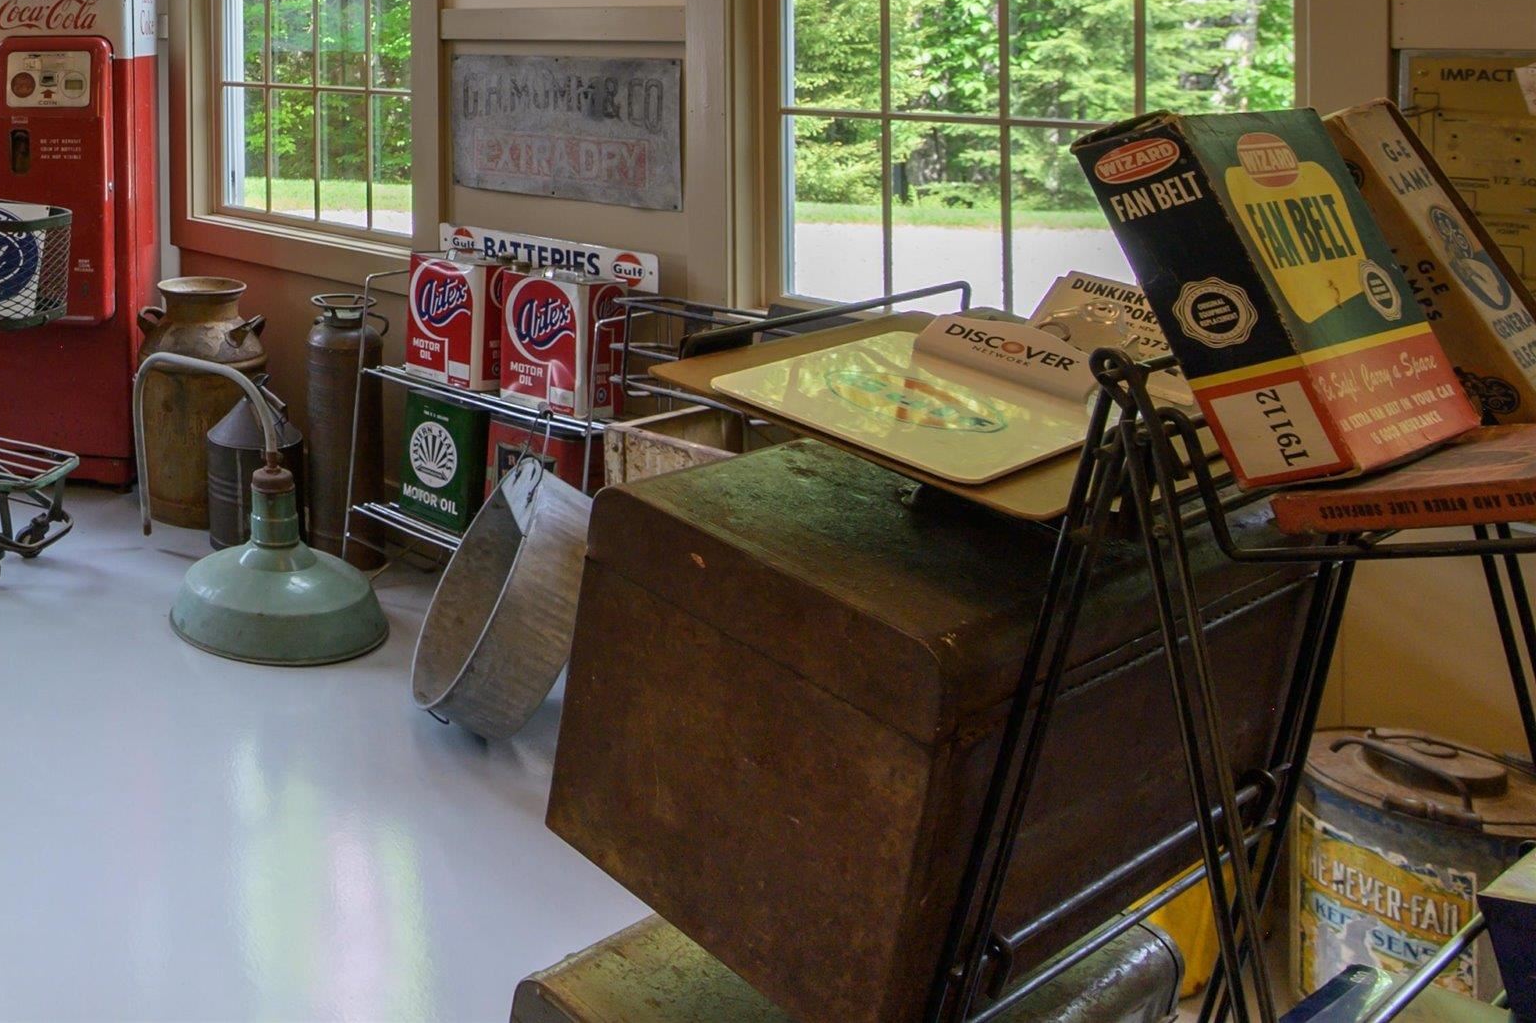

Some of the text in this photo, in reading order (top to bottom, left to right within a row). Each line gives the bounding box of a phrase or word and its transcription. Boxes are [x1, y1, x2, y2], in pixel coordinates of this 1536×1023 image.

[1440, 67, 1515, 83] IMPACT
[1098, 142, 1174, 177] WIZARD
[1239, 146, 1297, 173] WIZARD
[1109, 171, 1203, 222] FAN BELT
[1245, 194, 1357, 269] FAN BELT
[452, 236, 643, 277] Gulf BATTERIES Gulf
[1071, 278, 1148, 306] DUNKIRK
[412, 337, 440, 352] MOTOR
[419, 350, 432, 361] OIL
[945, 323, 1075, 371] DISCOVER
[971, 345, 1031, 367] NETWORK
[510, 361, 543, 378] MOTOR
[519, 374, 533, 386] OIL
[1411, 389, 1438, 406] YOUR
[1436, 383, 1456, 399] CAR
[1255, 389, 1309, 467] T9112
[403, 482, 459, 516] MOTOR OIL
[1319, 503, 1383, 519] SURFACES
